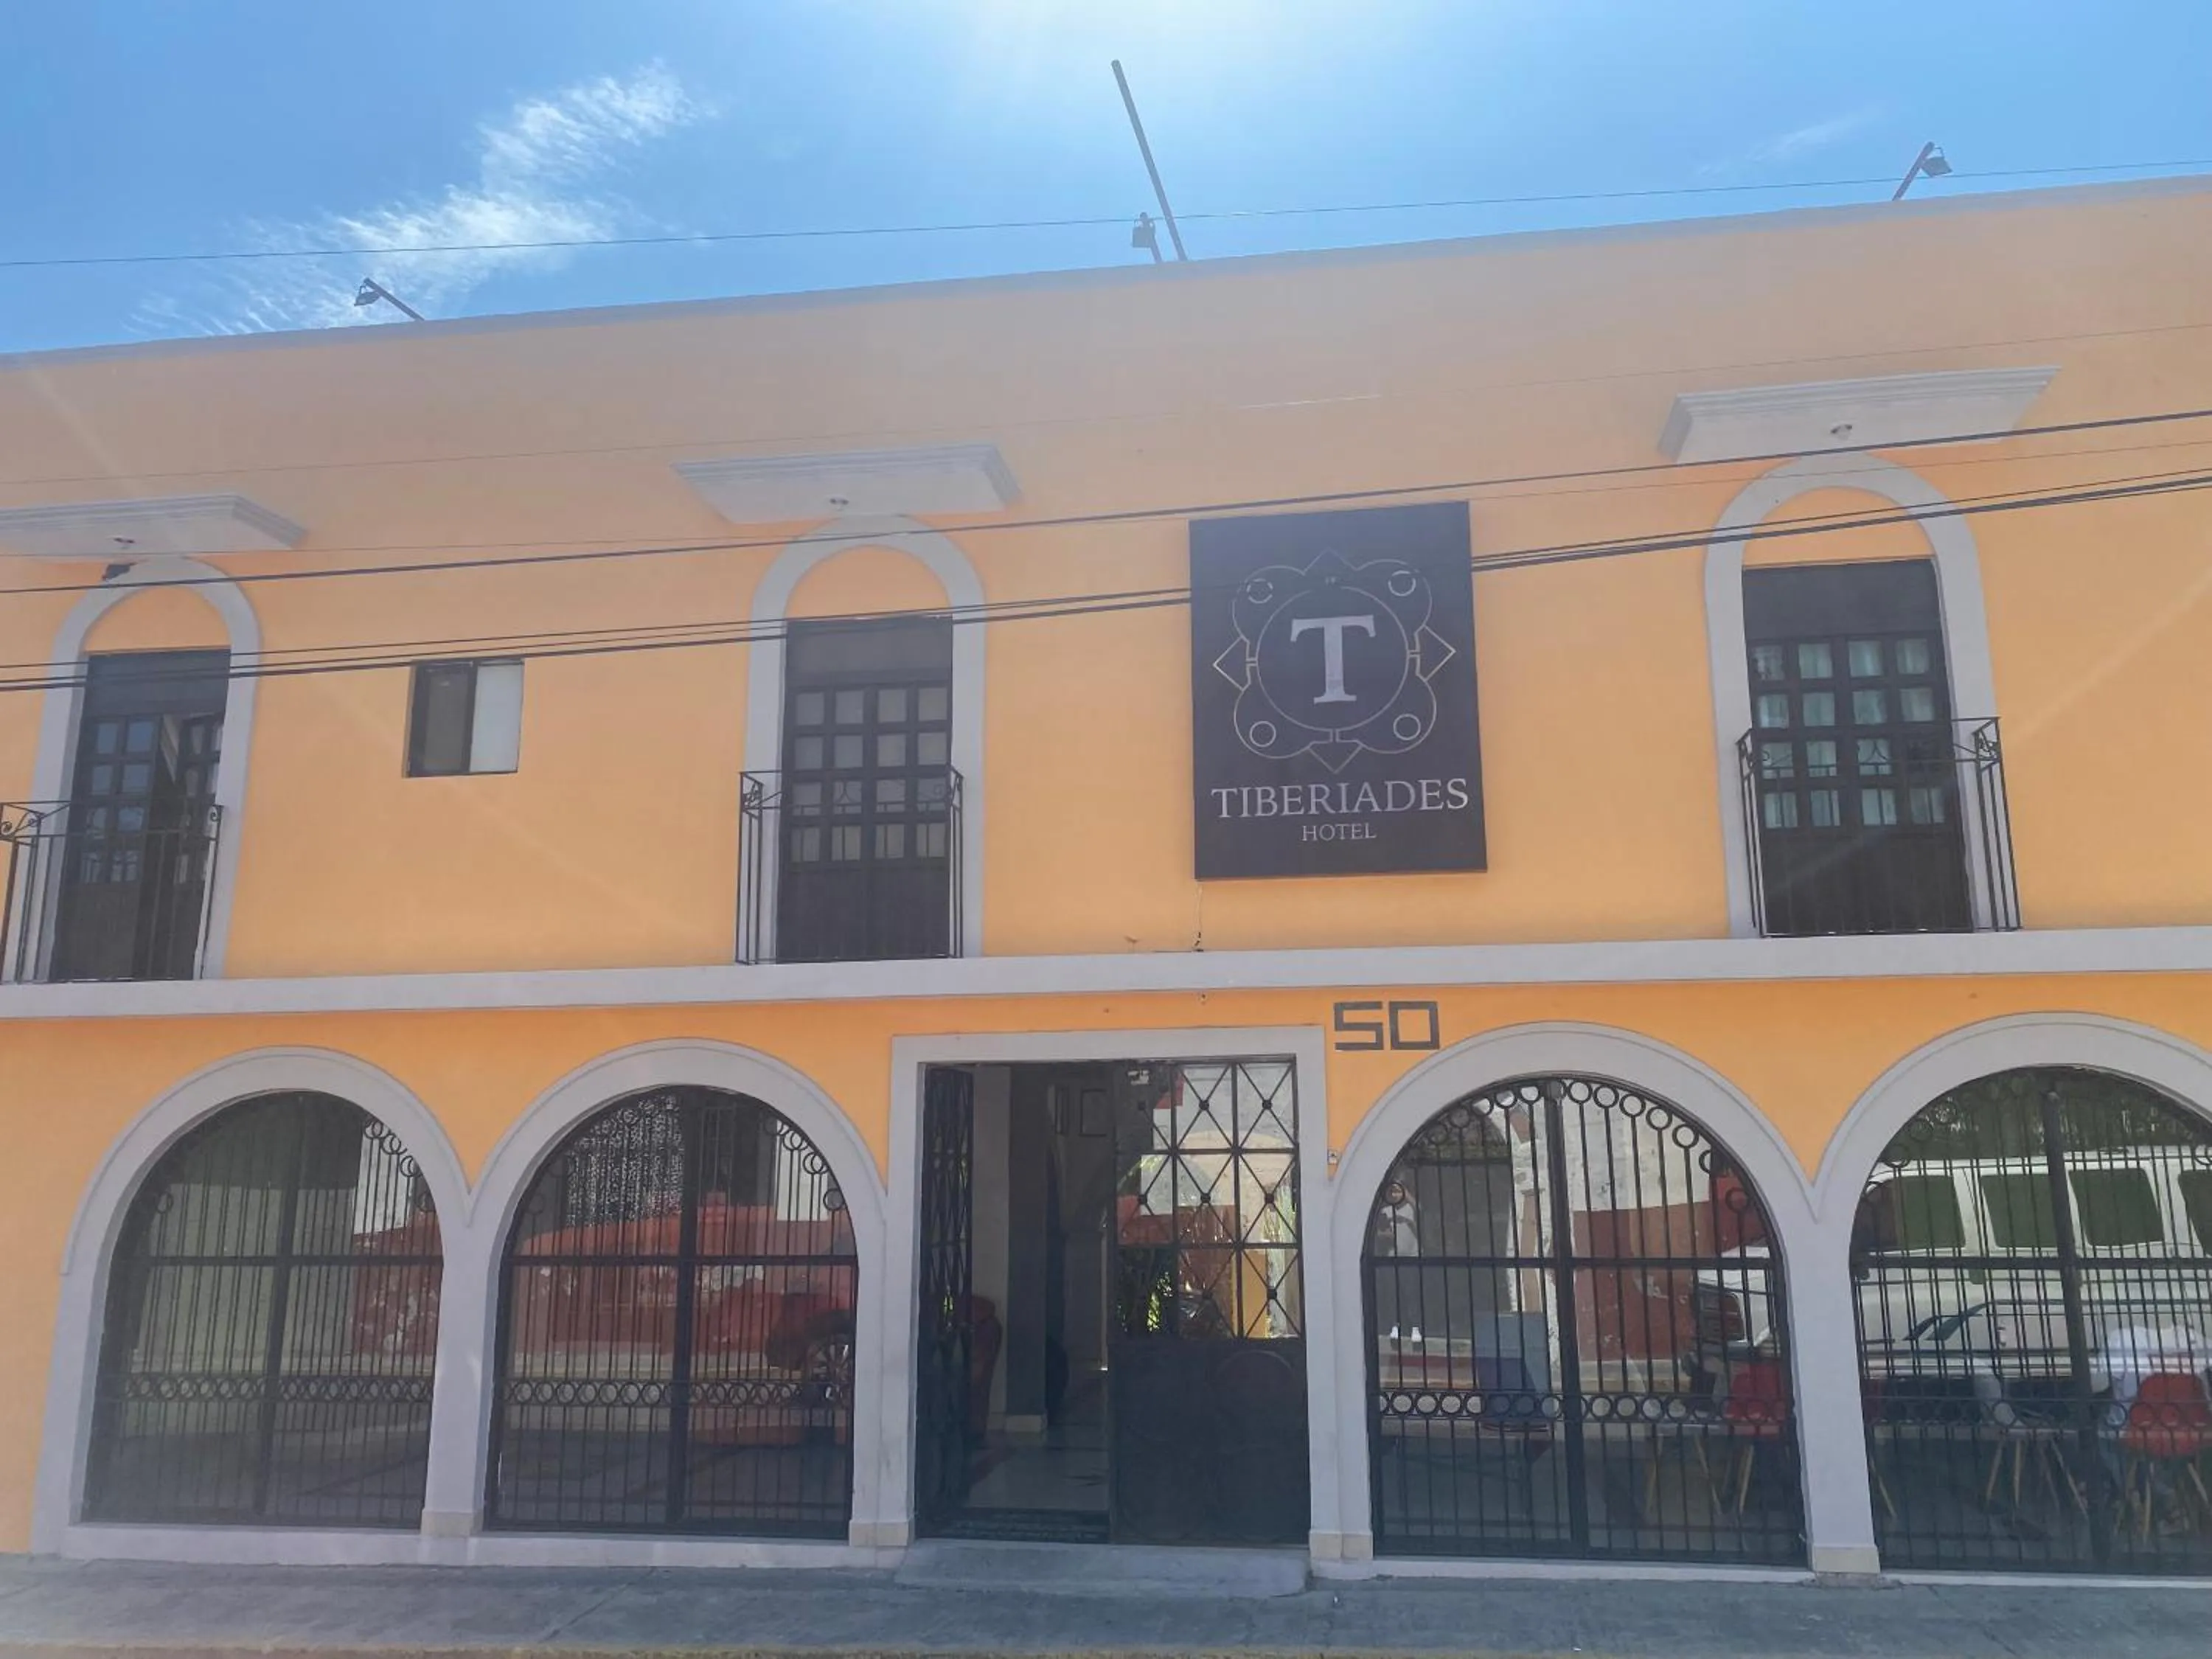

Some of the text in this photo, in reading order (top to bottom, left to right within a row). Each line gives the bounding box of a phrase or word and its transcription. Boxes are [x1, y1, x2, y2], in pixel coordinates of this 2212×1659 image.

[1290, 613, 1376, 704] T
[1211, 778, 1470, 818] TIBERIADES
[1301, 822, 1377, 841] HOTEL
[1333, 1001, 1440, 1050] 50
